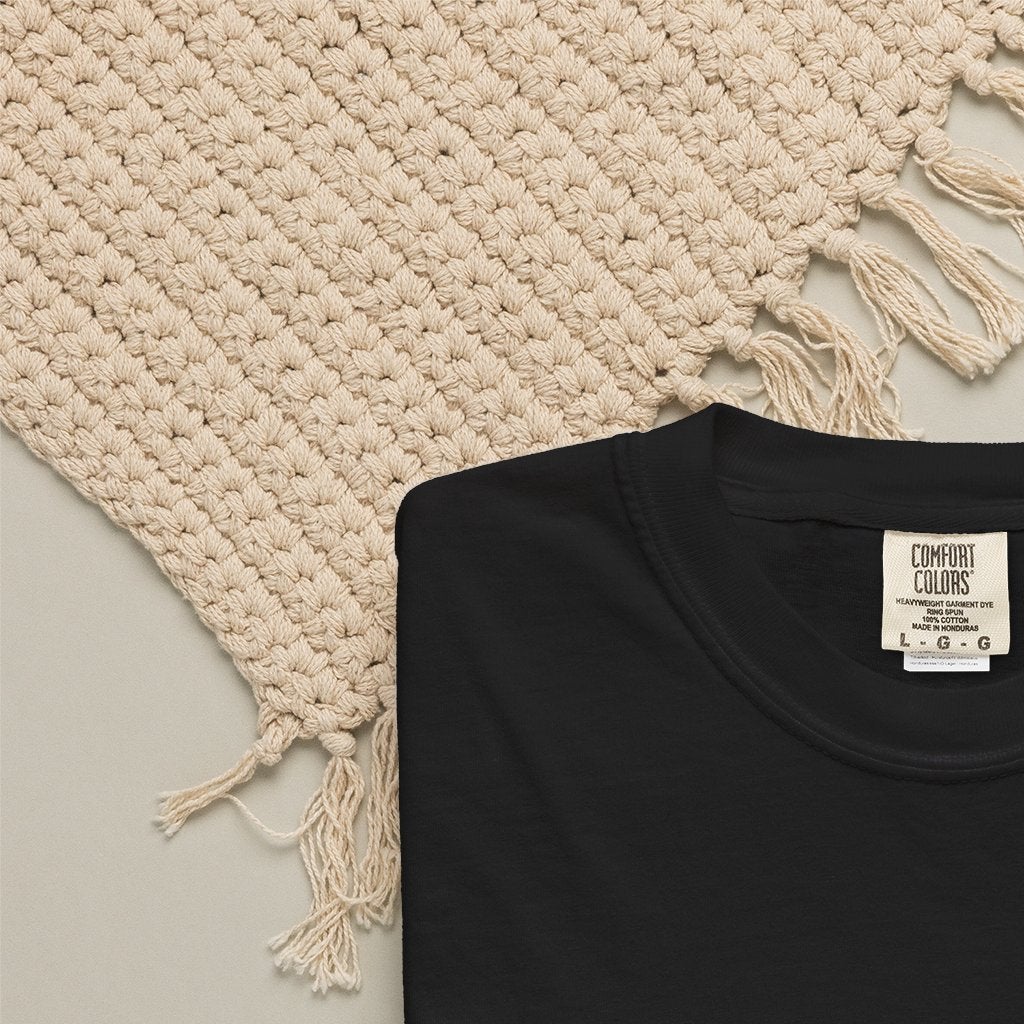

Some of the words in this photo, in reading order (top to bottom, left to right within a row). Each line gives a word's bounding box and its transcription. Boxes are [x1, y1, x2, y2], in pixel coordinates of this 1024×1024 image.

[911, 543, 975, 568] COMFORT
[896, 598, 944, 607] HEAVYWEIGHT
[912, 623, 931, 631] MADE
[899, 633, 910, 647] L
[937, 636, 950, 649] G
[978, 636, 991, 650] G
